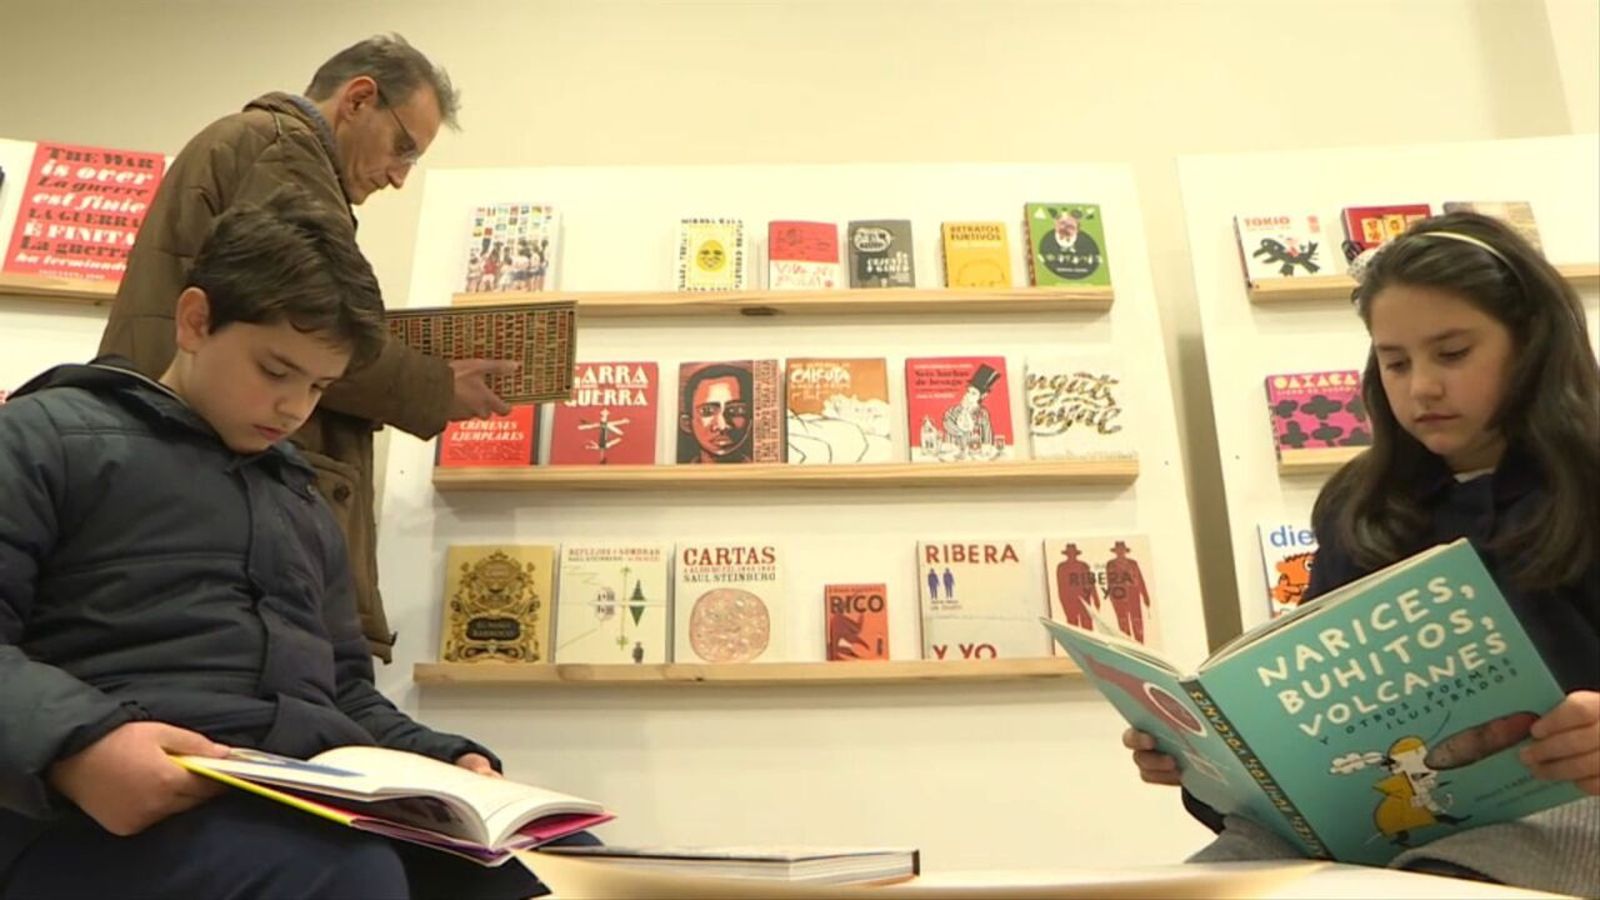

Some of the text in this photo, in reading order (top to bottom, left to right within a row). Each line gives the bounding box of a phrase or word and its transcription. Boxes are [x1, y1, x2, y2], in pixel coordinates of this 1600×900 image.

[46, 146, 154, 169] THE WAR
[40, 159, 155, 185] is over
[37, 176, 149, 196] La guerre
[32, 192, 146, 213] est finie
[950, 225, 1000, 233] RETRATOS
[1243, 215, 1291, 227] TOKIO
[20, 235, 50, 251] La
[951, 233, 1002, 241] FURTIVOS
[43, 255, 127, 272] terminad
[495, 314, 504, 360] CALAMIT
[505, 314, 514, 352] ANNIE
[515, 314, 524, 361] SITTING
[790, 366, 852, 385] CALCUTA
[1273, 373, 1357, 390] OAXACA
[451, 431, 525, 442] EJEMPLARES
[683, 546, 776, 567] CARTAS
[925, 543, 1020, 564] RIBERA
[683, 573, 776, 583] SAUL STEINBERG
[1069, 571, 1134, 586] RIBERA
[1100, 586, 1127, 601] YO
[829, 594, 885, 614] RICO
[1257, 576, 1475, 689] NARICES,
[958, 644, 998, 660] YO
[1277, 608, 1495, 715] BUHITOS,
[1298, 631, 1508, 738] VOLCANES
[1319, 658, 1512, 747] Y OTROS POEMAS
[1385, 668, 1519, 731] ILUSTRADOS
[1189, 689, 1247, 755] VOLCANES
